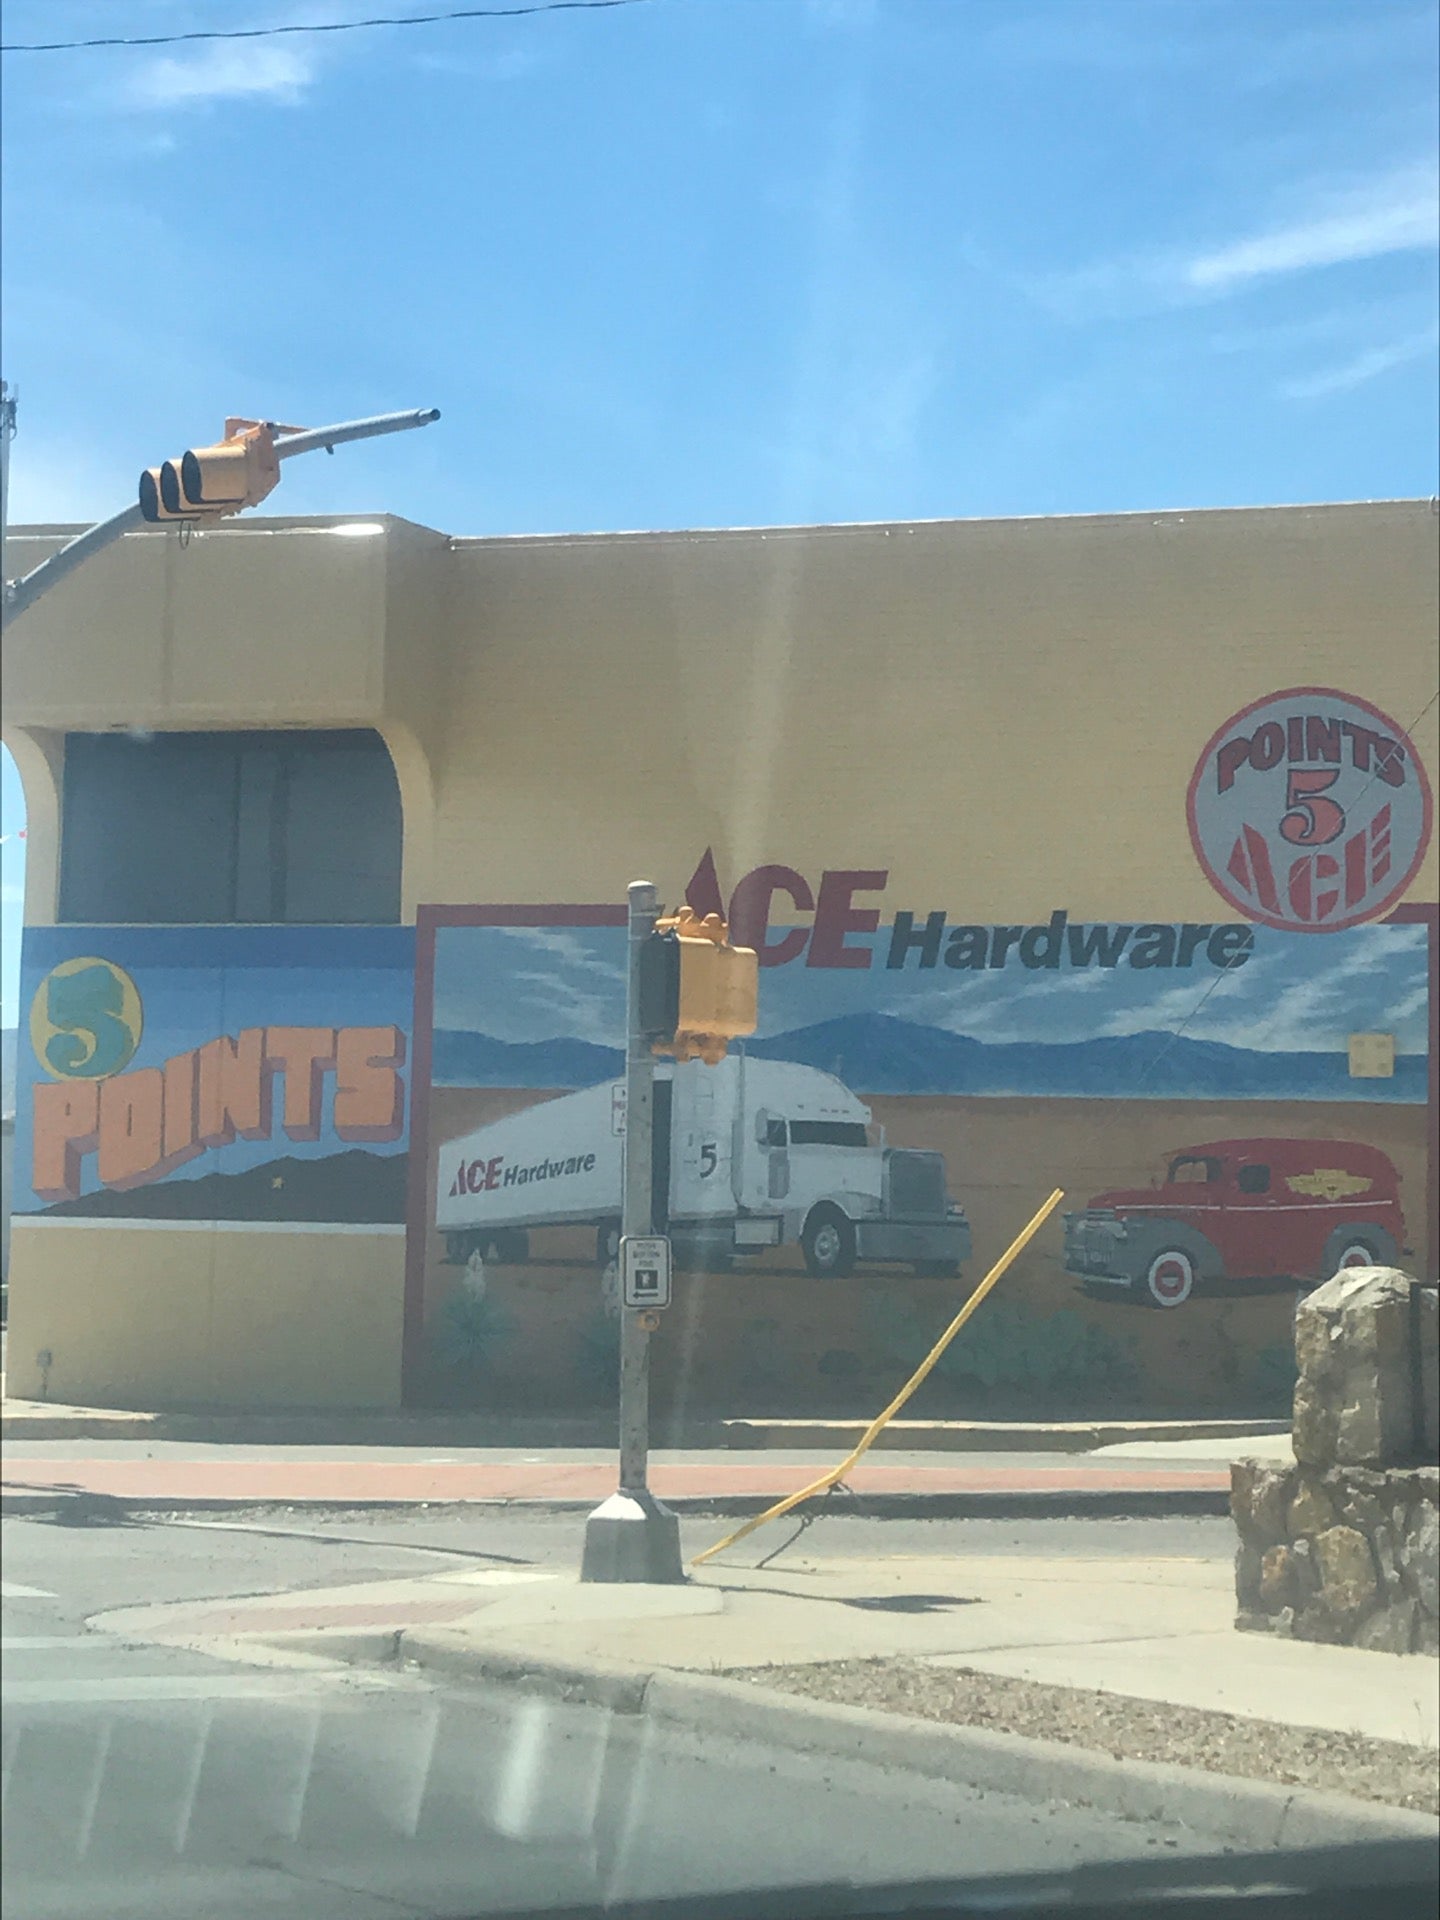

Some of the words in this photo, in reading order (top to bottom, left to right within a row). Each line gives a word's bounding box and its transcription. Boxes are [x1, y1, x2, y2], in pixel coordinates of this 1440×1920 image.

[1217, 716, 1406, 796] POINTS
[1278, 768, 1346, 847] 5
[1226, 801, 1392, 922] ACE
[885, 910, 1256, 970] Hardware
[45, 964, 135, 1078] 5
[32, 1024, 407, 1203] POINTS
[449, 1156, 504, 1197] ACE
[503, 1153, 597, 1187] Hardware
[699, 1143, 717, 1178] 5
